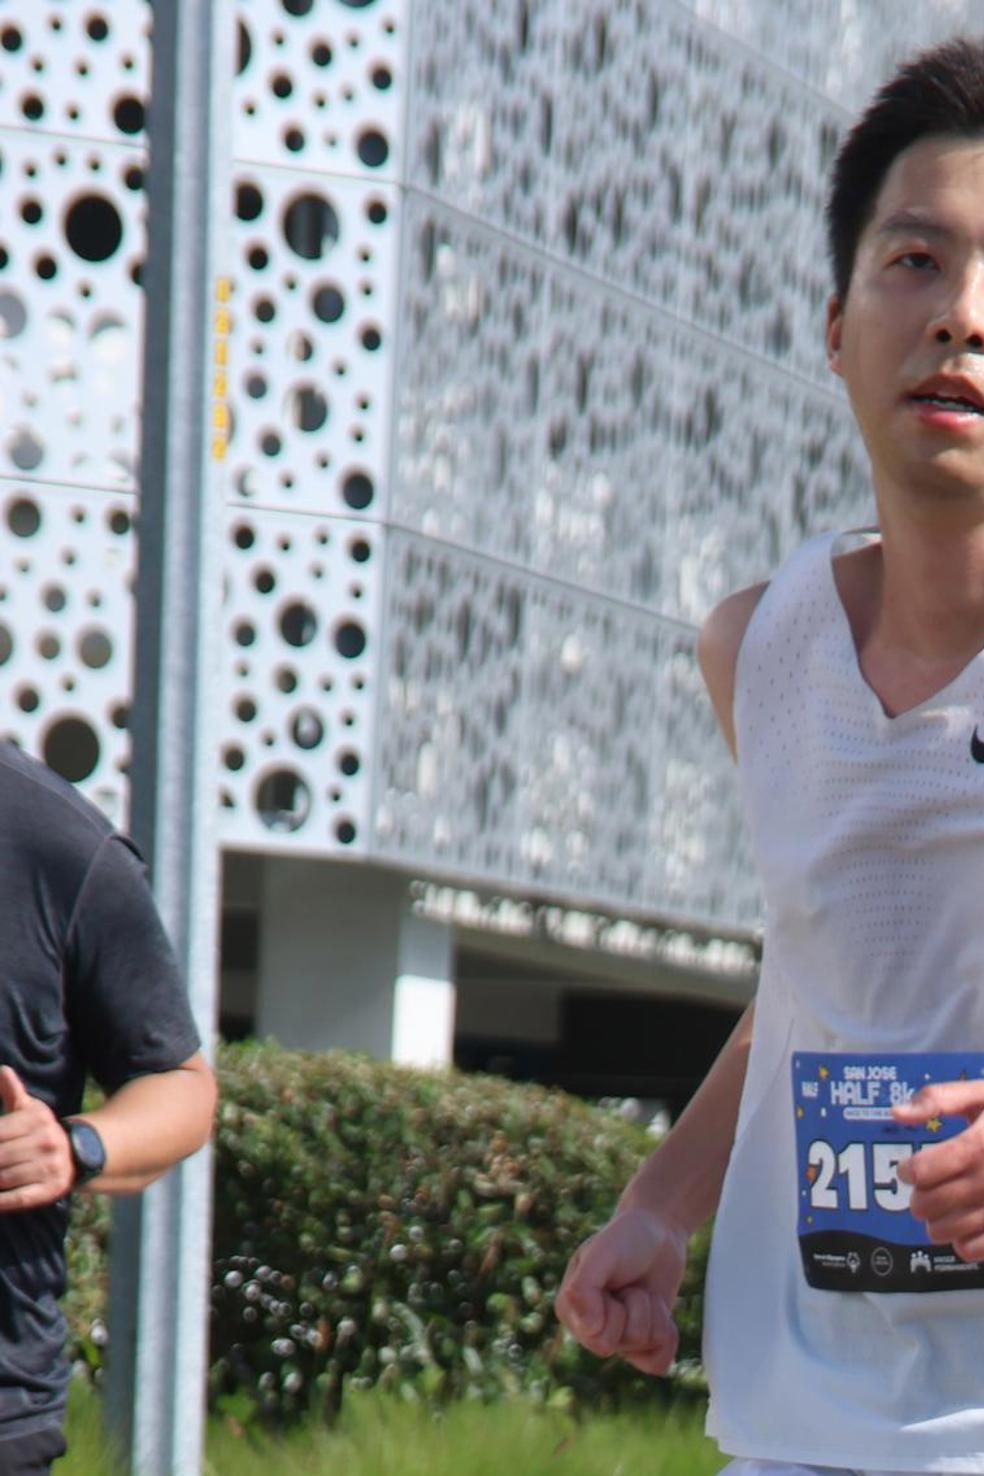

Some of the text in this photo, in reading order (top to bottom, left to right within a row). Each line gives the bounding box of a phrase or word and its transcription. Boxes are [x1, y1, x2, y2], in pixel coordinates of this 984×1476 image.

[843, 1066, 897, 1080] SAN JOSE
[830, 1081, 881, 1105] HALF
[808, 1140, 946, 1212] 215
